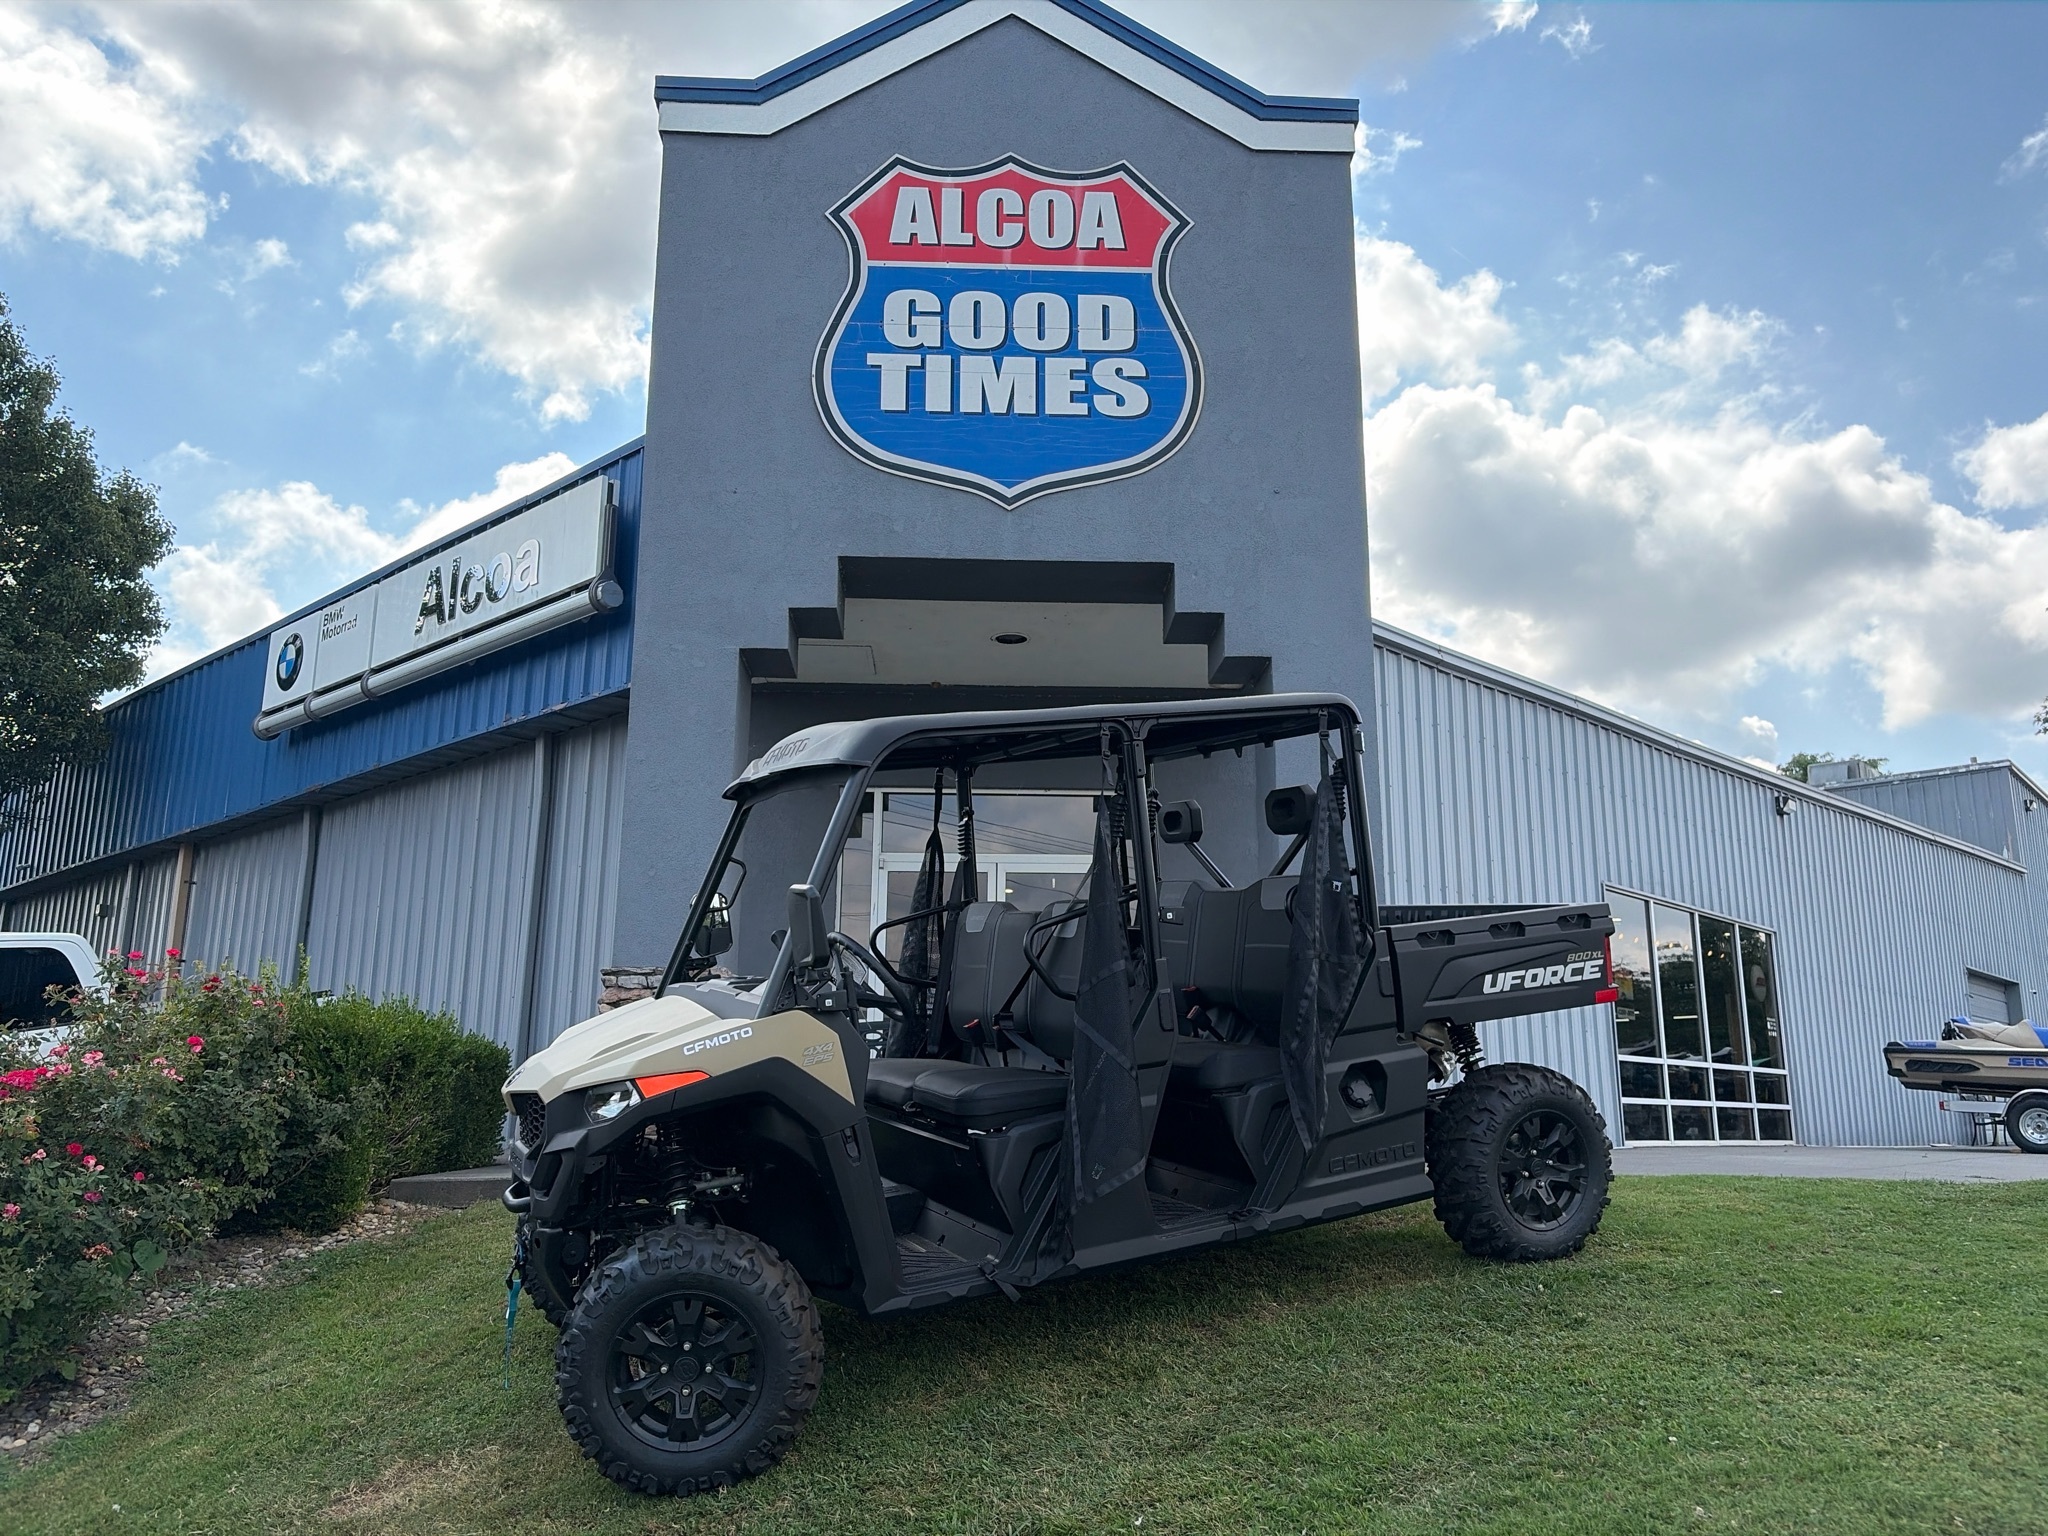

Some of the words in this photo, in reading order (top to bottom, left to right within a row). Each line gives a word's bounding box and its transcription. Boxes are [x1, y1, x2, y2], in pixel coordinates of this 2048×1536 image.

[889, 186, 1127, 251] ALCOA
[883, 289, 1136, 353] GOOD
[867, 353, 1150, 418] TIMES
[414, 539, 540, 635] Alcoa
[321, 613, 358, 642] Motorrad
[323, 605, 345, 627] BMW
[1566, 951, 1605, 962] 800XL
[1482, 959, 1604, 994] UFORCE
[683, 1027, 753, 1056] CFMOTO
[803, 1052, 834, 1067] EPS
[1328, 1141, 1416, 1174] CFMOTO
